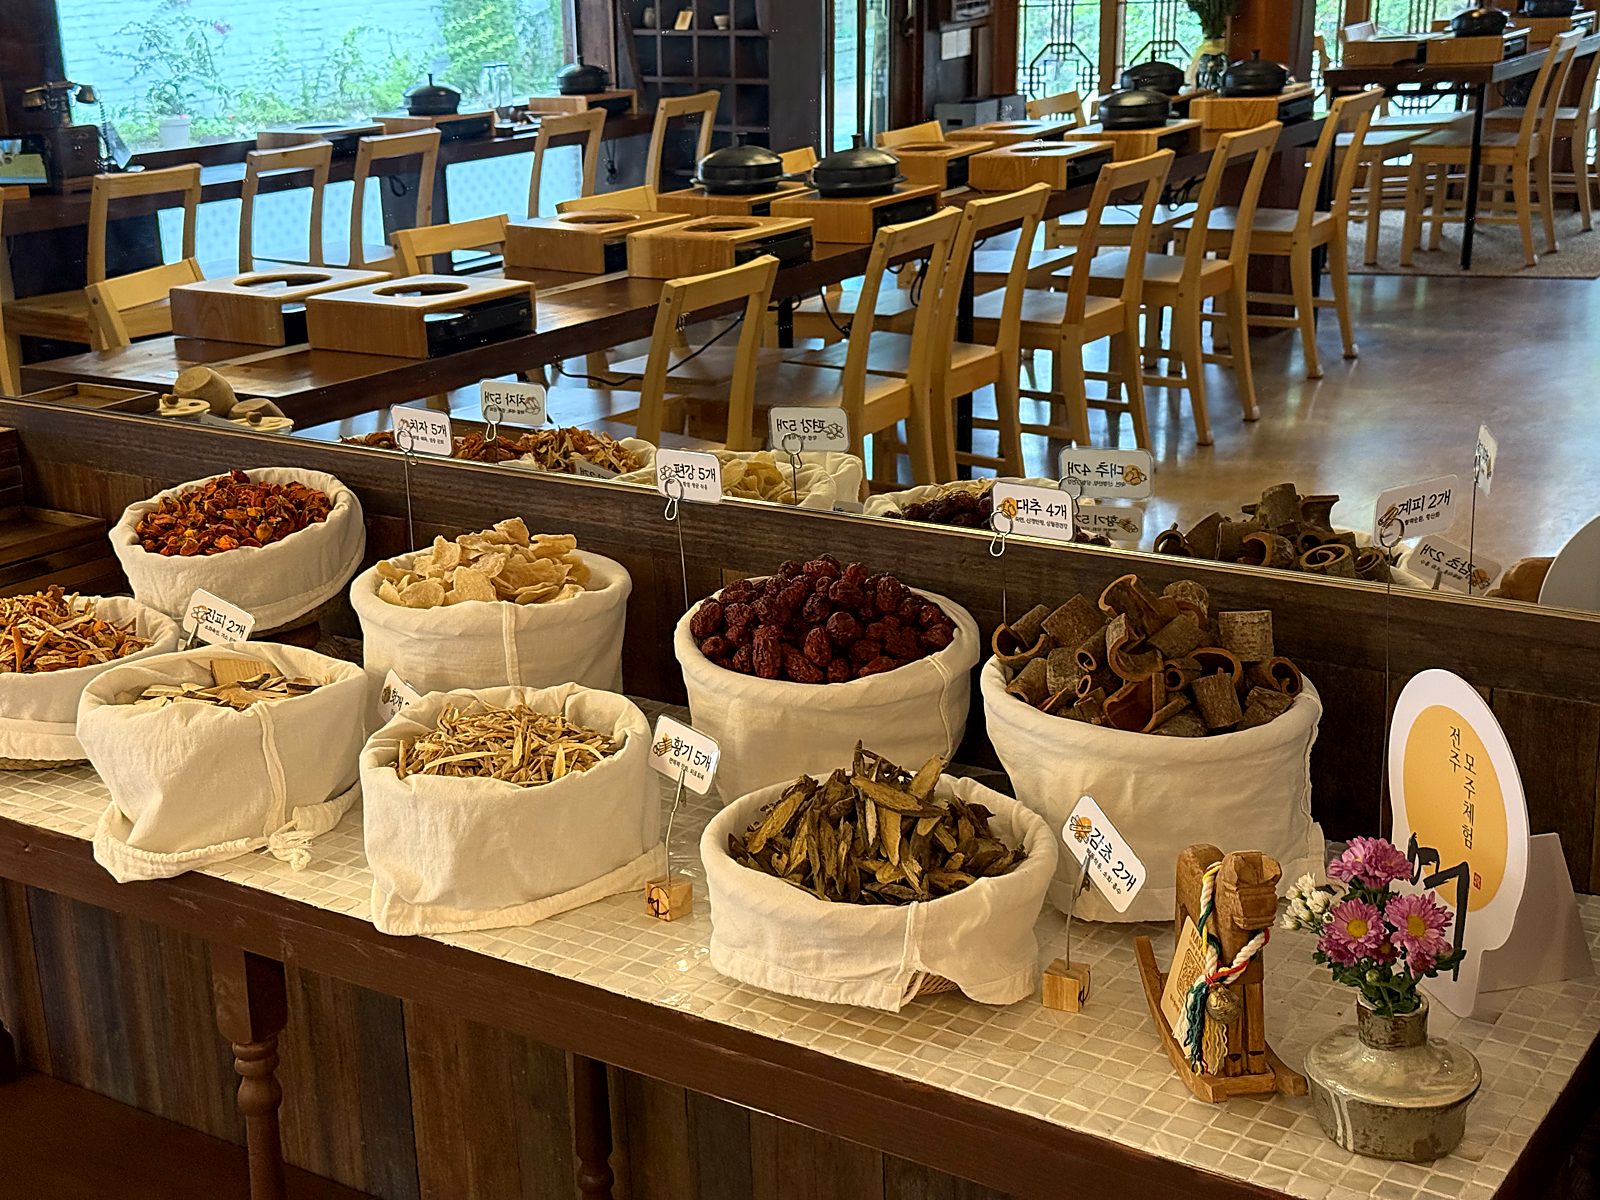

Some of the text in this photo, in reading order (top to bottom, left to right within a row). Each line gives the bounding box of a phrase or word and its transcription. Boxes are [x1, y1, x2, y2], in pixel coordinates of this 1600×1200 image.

[410, 418, 448, 438] 치자 5개
[673, 463, 716, 483] 편강 5개
[1016, 498, 1067, 520] 대추 4개
[1398, 489, 1451, 515] 계피 2개
[204, 607, 227, 628] 진피
[226, 620, 246, 639] 2개
[671, 737, 712, 772] 황기 5개
[1449, 726, 1462, 773] 전주
[1461, 752, 1477, 850] 모주체험
[1088, 827, 1113, 864] 감초
[1111, 860, 1137, 892] 2개
